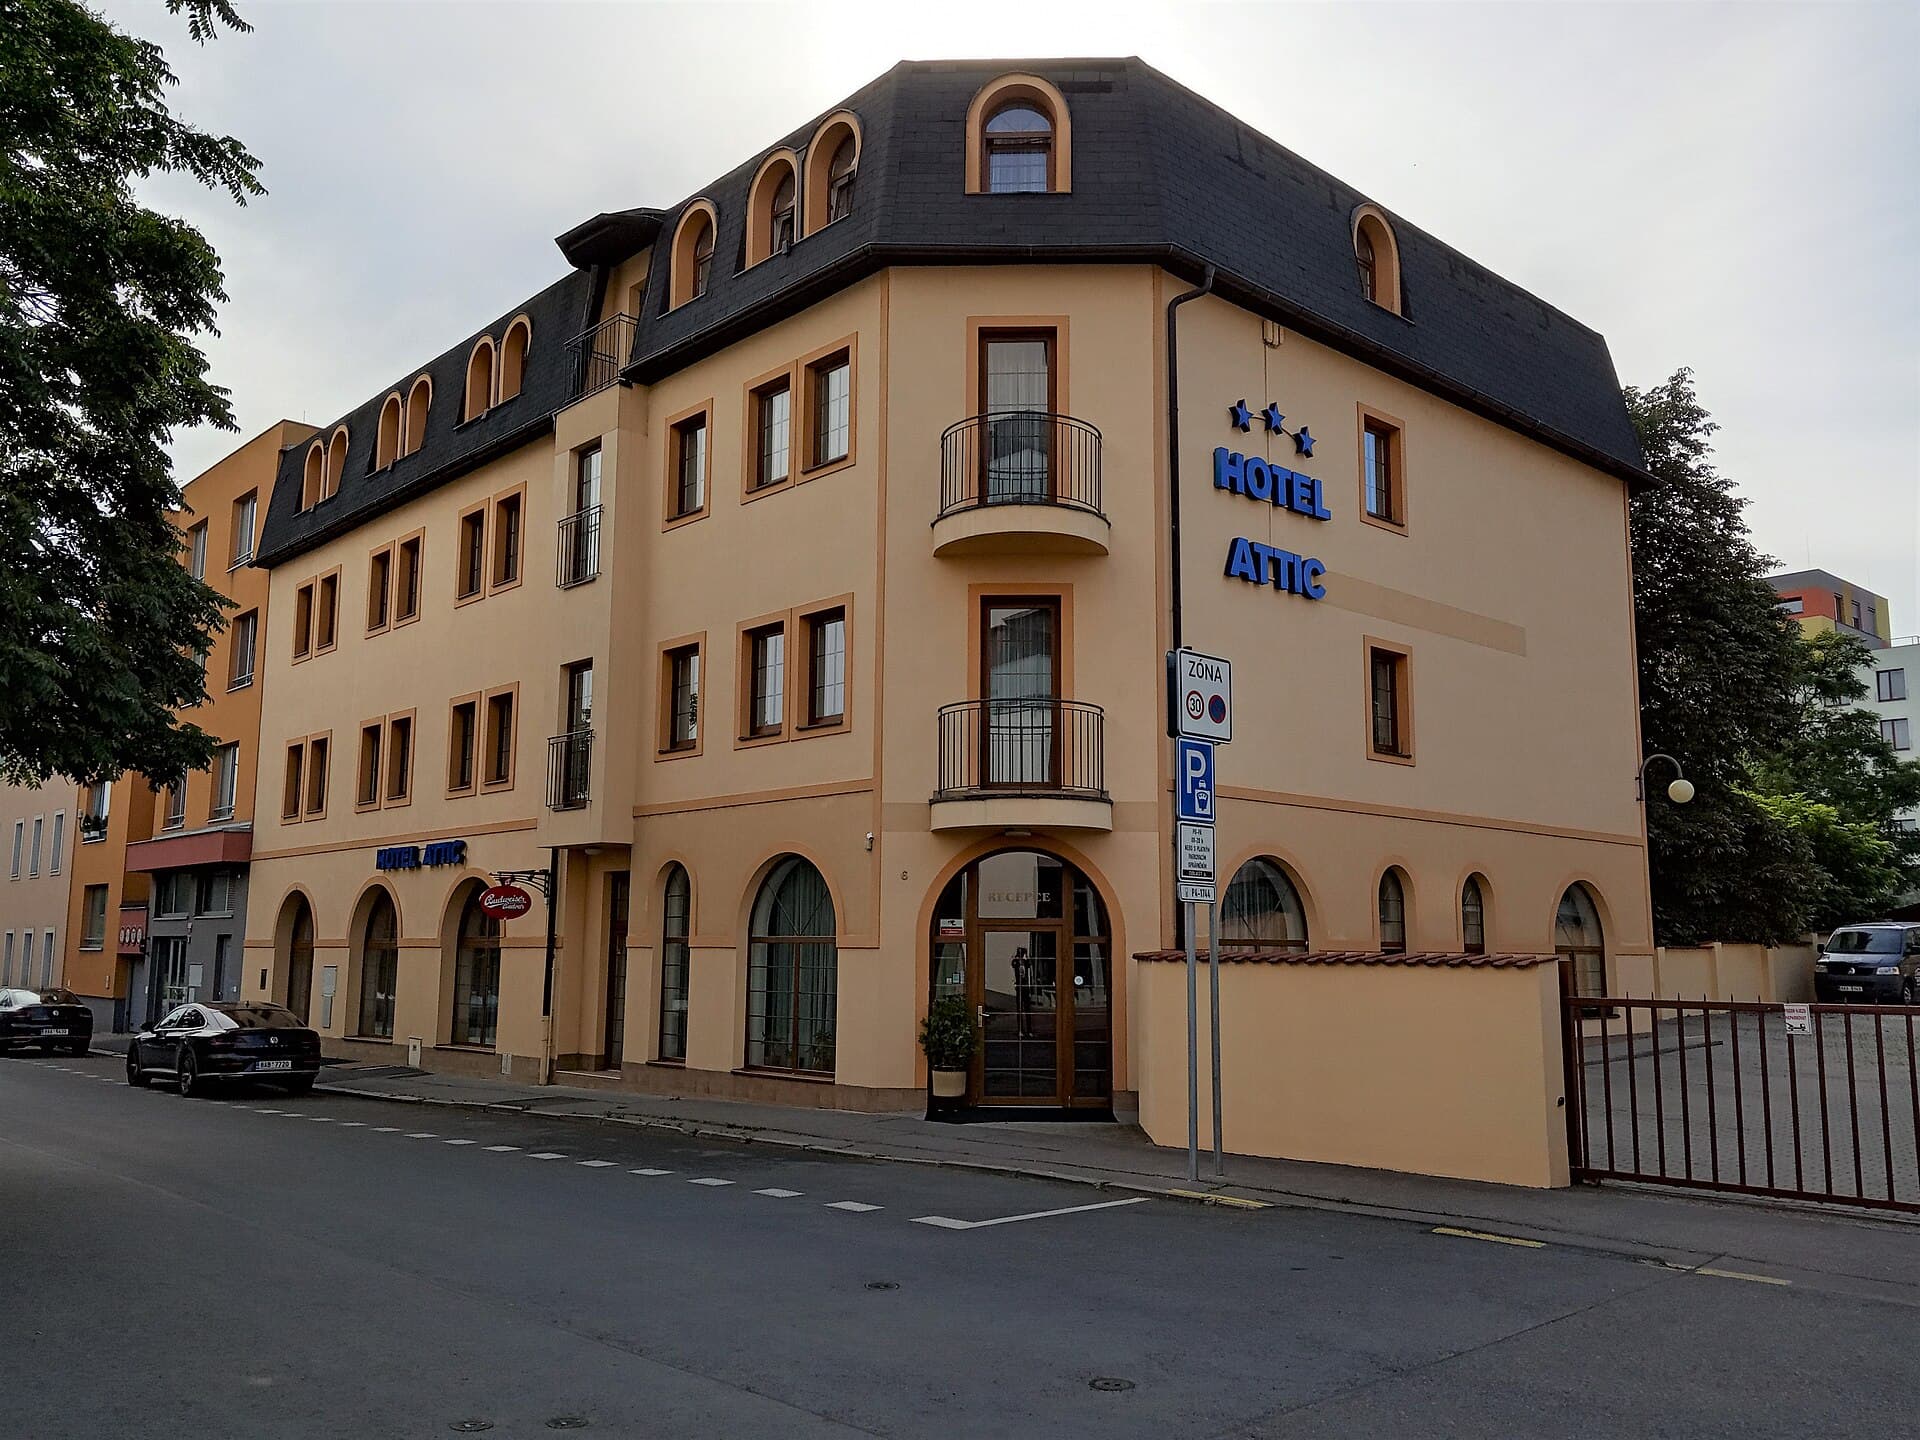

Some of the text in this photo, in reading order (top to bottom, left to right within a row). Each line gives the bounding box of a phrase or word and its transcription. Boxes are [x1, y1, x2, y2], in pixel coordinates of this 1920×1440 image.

[1213, 446, 1331, 521] HOTEL
[1224, 537, 1326, 600] ATTIC
[1188, 658, 1223, 684] ZÓNA
[1189, 697, 1202, 713] 30
[1186, 749, 1206, 794] P
[376, 840, 466, 870] HOTEL ATTIC
